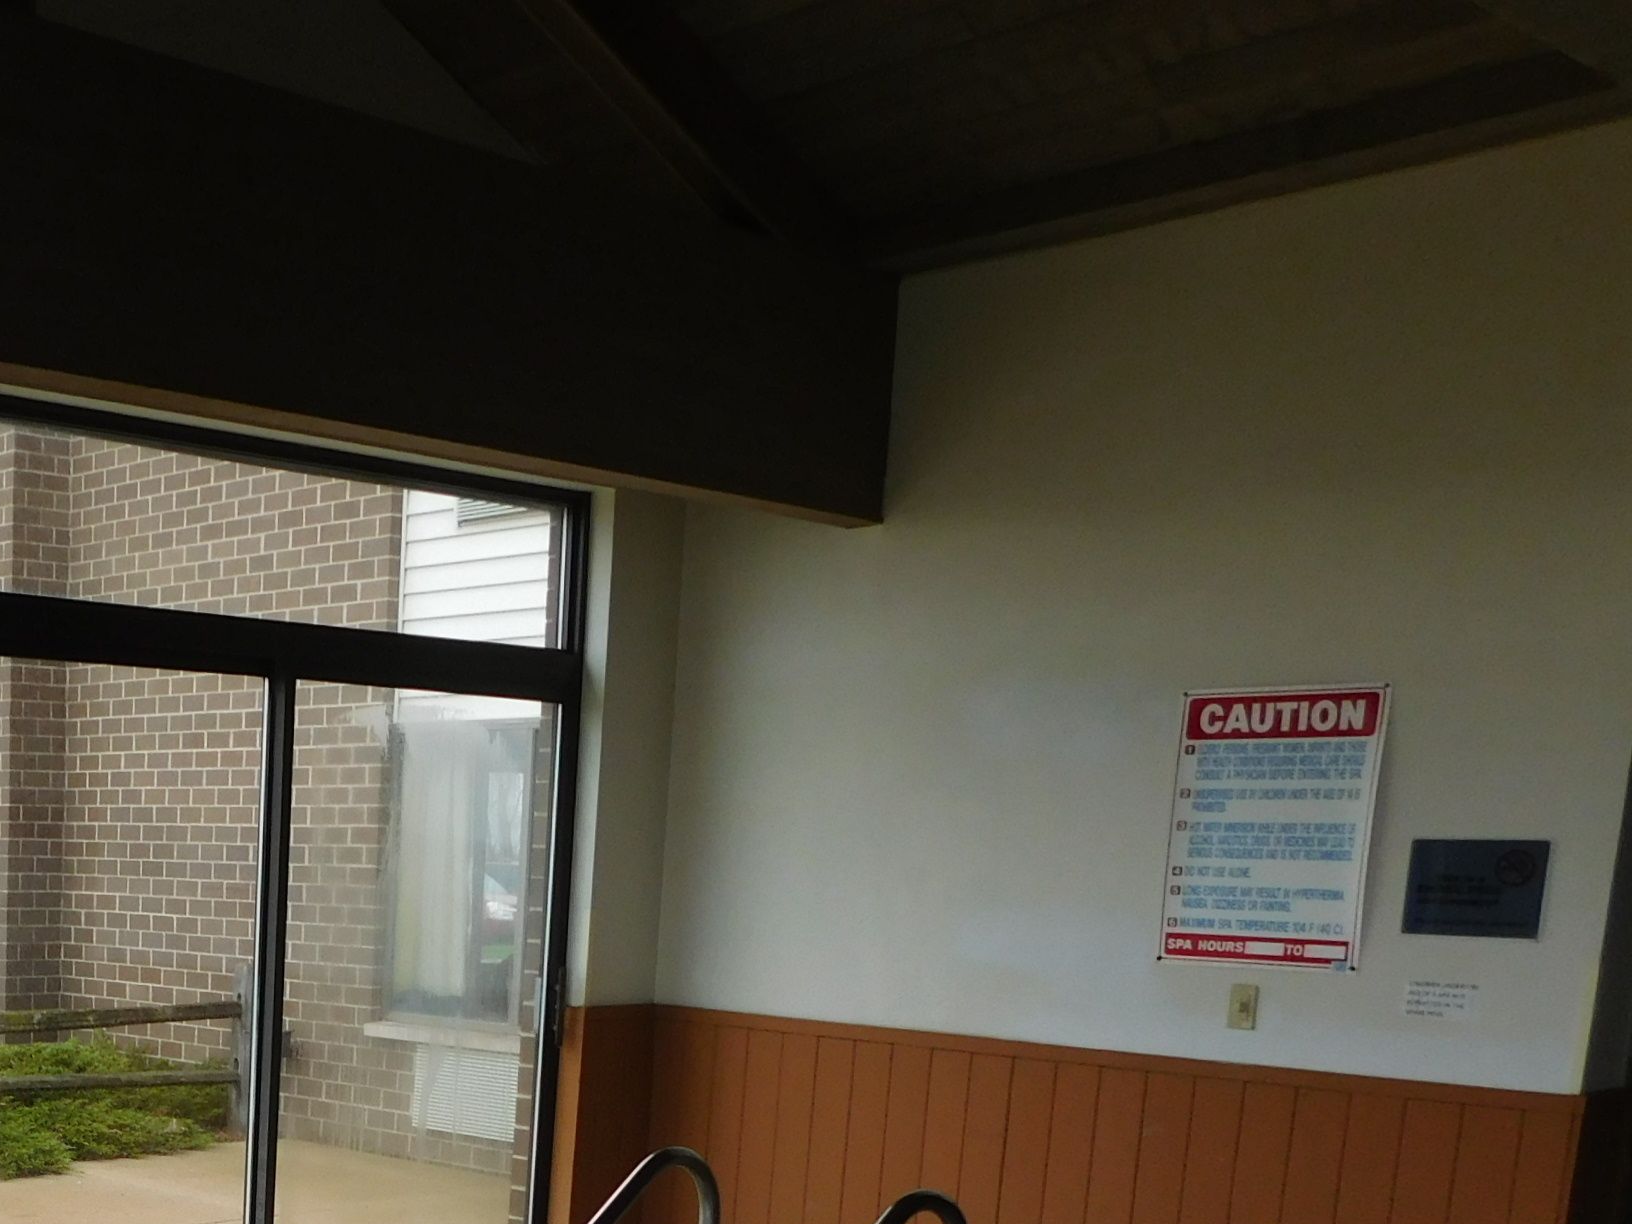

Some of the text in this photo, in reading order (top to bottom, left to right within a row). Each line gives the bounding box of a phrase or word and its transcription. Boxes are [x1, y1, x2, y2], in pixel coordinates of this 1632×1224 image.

[1199, 699, 1366, 734] CAUTION
[1167, 938, 1304, 956] SPA HOURS TO
